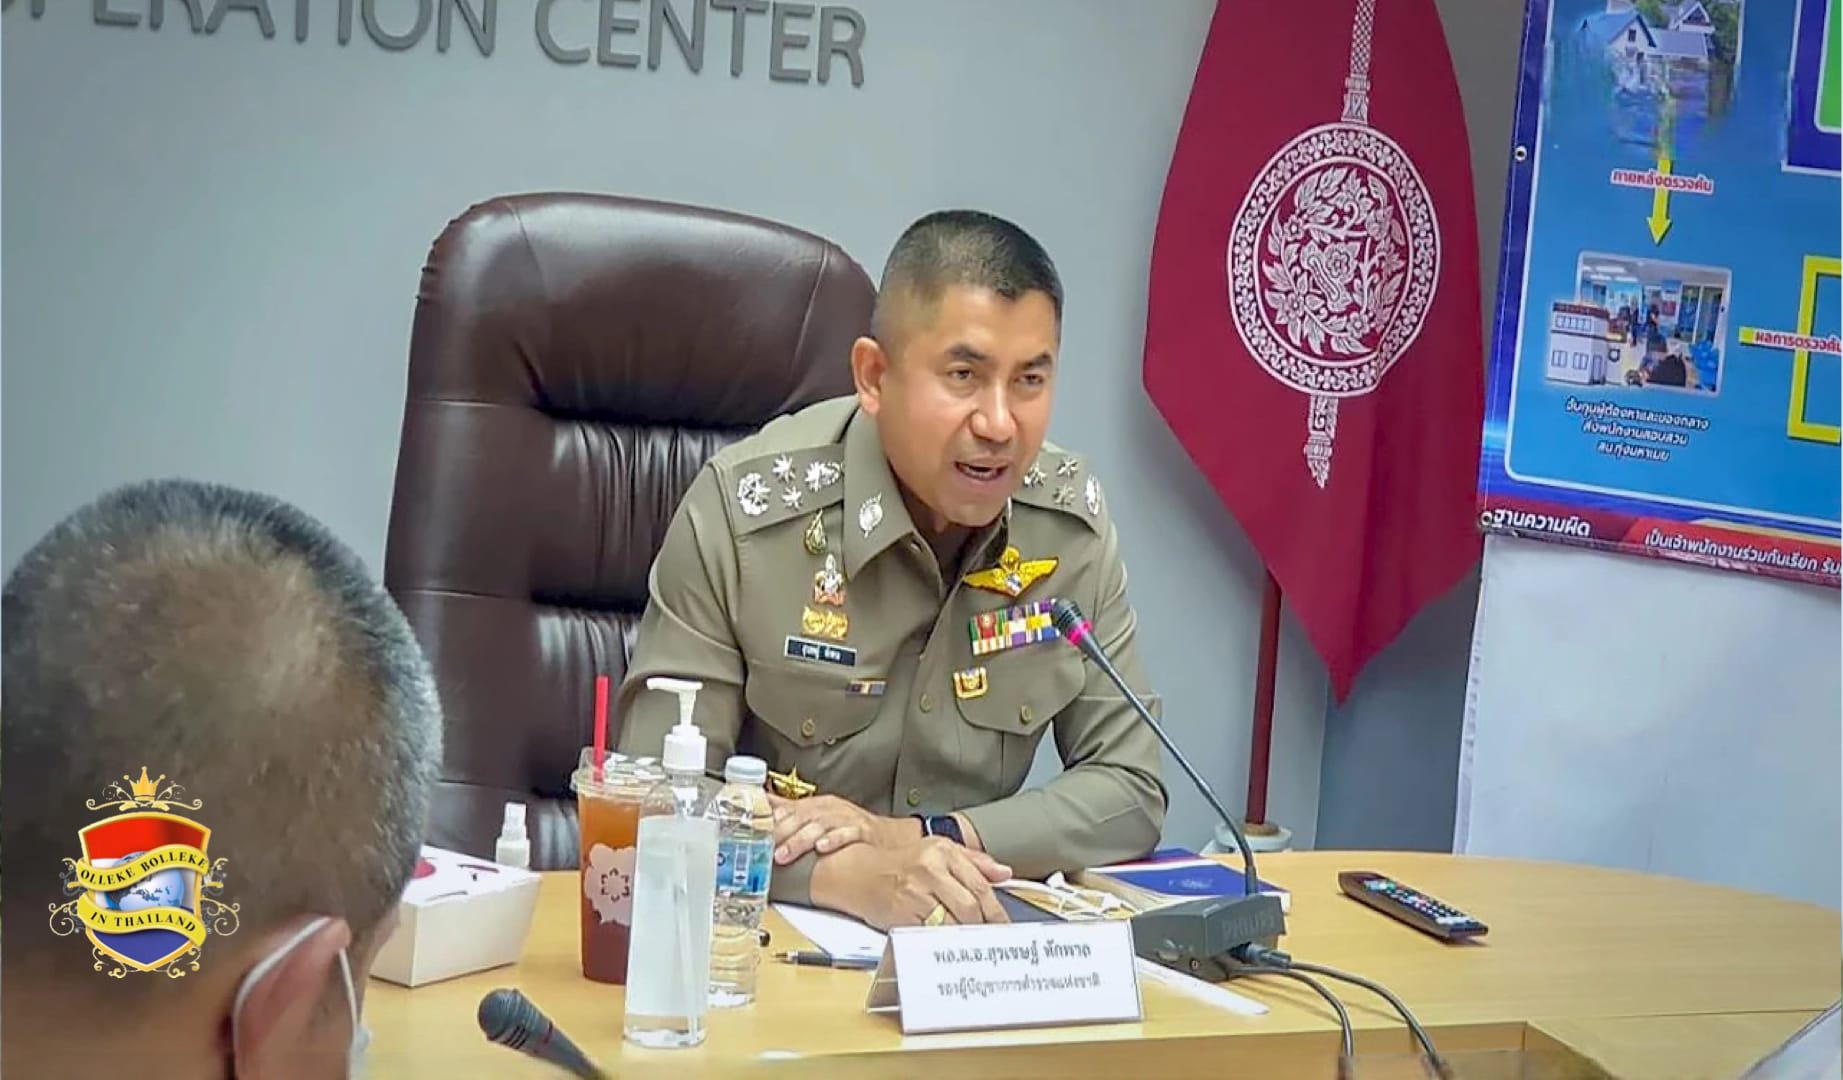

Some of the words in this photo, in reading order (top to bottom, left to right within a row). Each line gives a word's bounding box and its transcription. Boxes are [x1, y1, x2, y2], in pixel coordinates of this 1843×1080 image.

[2, 0, 497, 58] ATION
[535, 0, 866, 89] CENTER
[1493, 508, 1591, 537] ฐานความผิด
